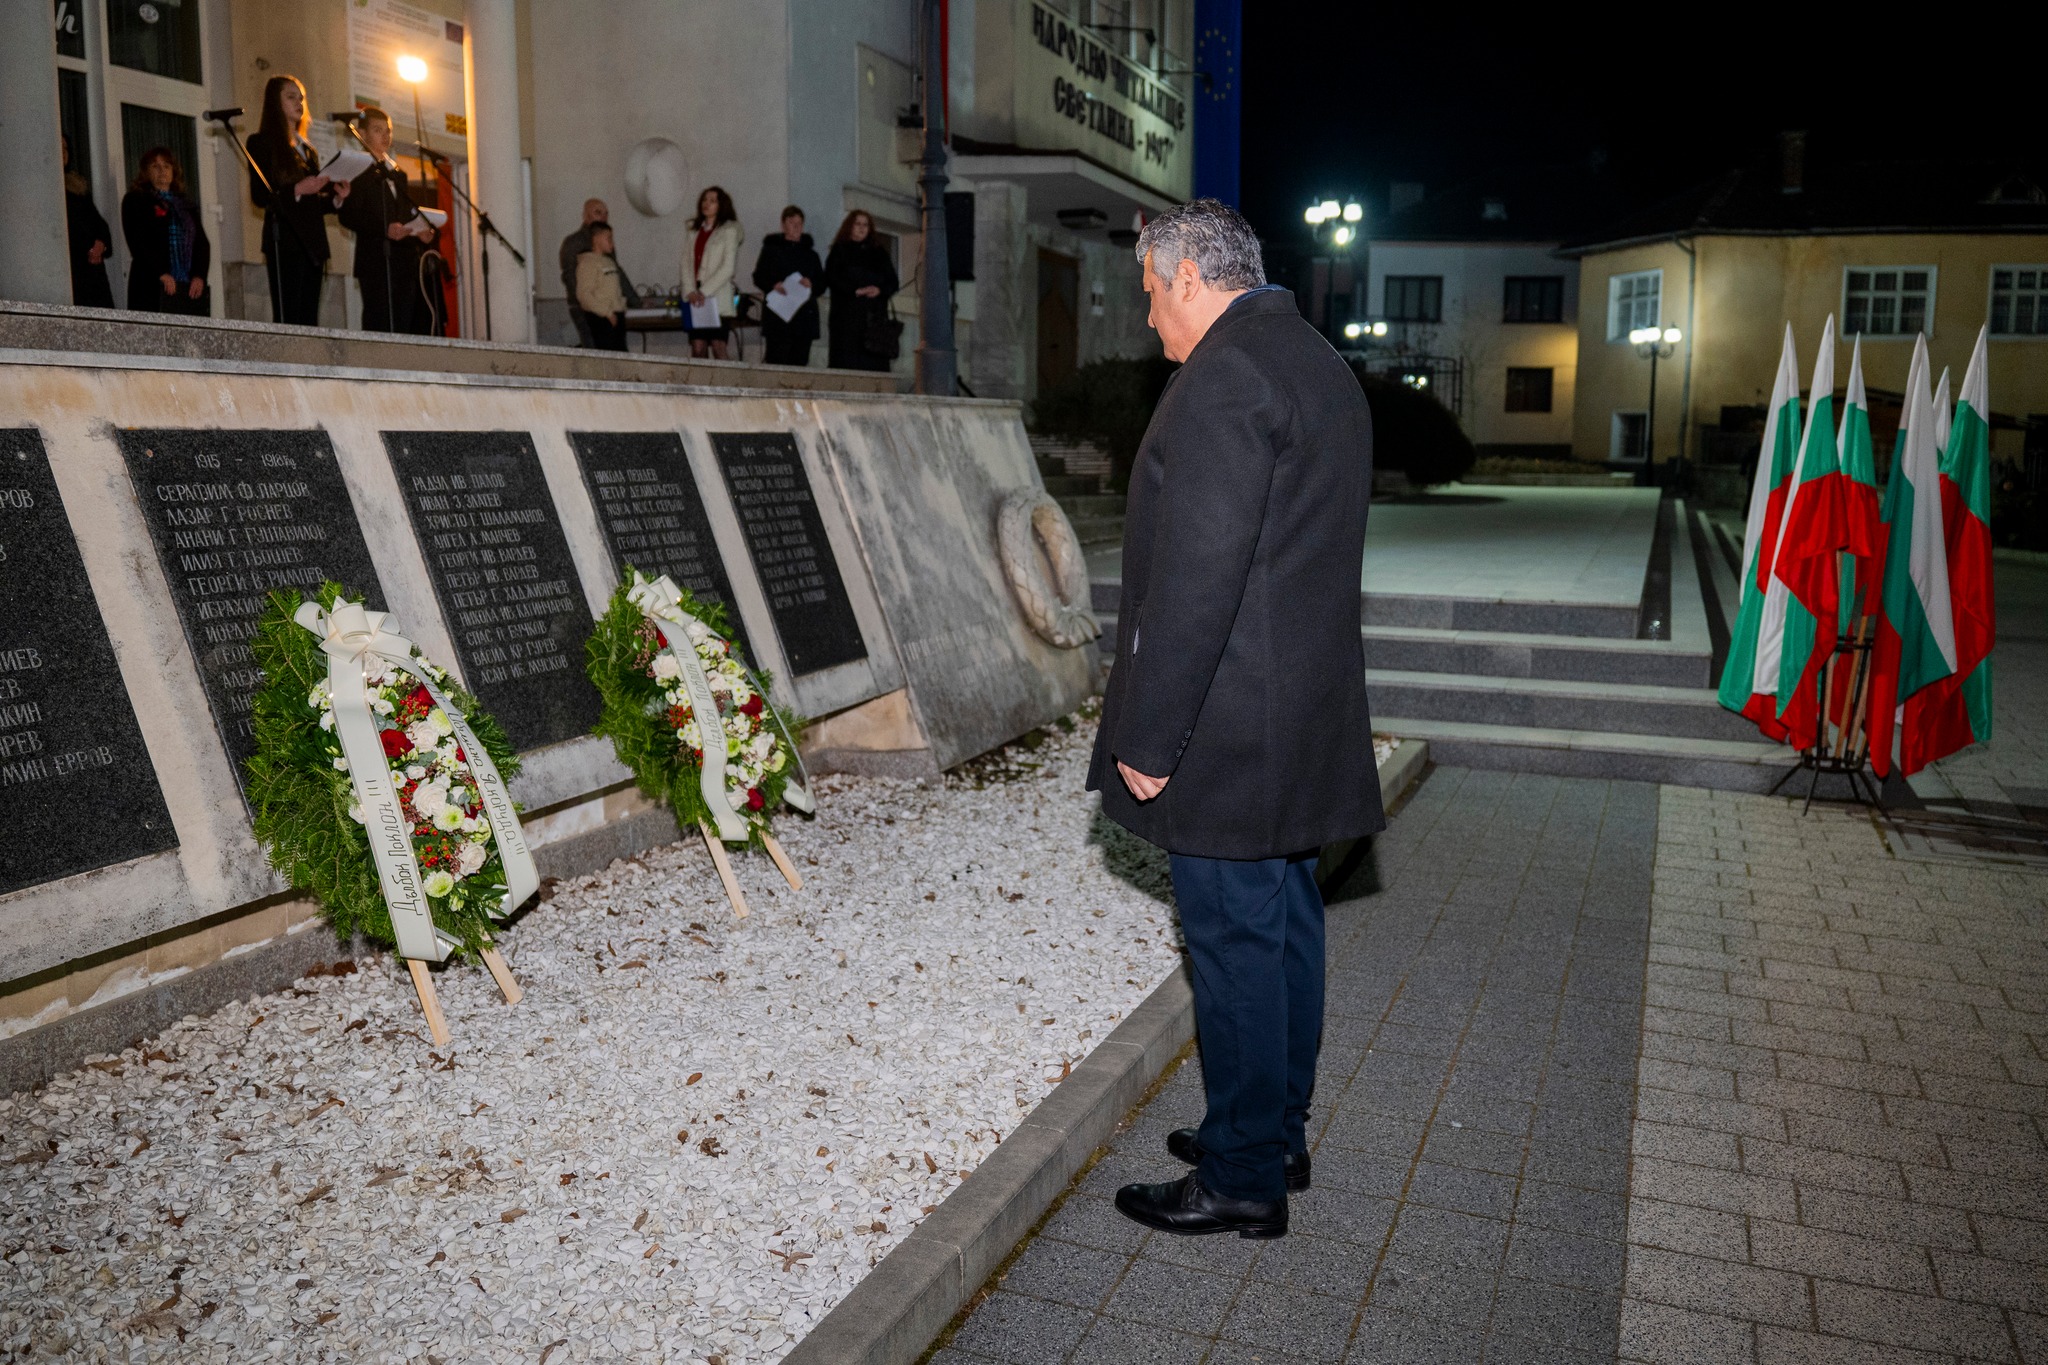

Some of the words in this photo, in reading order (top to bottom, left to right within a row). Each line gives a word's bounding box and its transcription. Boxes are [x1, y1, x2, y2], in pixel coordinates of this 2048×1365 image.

[194, 453, 220, 468] 1915
[412, 474, 448, 492] РАДУЛ
[593, 470, 626, 484] НИКОЛА
[156, 483, 234, 502] СЕРАФИМ
[419, 495, 450, 511] ИВАН
[166, 507, 213, 526] ЛАЗАР
[425, 513, 467, 530] ХРИСТО
[479, 509, 545, 526] ШАЛАМАНОВ
[175, 530, 225, 549] АНАНИ
[433, 532, 466, 549] АНГЕЛ
[480, 528, 521, 545] МАНЧЕВ
[180, 553, 223, 572] ИЛИЯ
[439, 550, 480, 569] ГЕОРГИ
[187, 574, 248, 596] ГЕОРГИ
[446, 571, 481, 589] ПЕТЪР
[453, 590, 488, 608] ПЕТЪР
[458, 608, 499, 627] НИКОЛА
[465, 629, 493, 646] СПАС
[0, 648, 42, 671] ИЕВ
[473, 648, 508, 667] ВАСИЛ
[480, 667, 508, 686] АСАН
[380, 800, 411, 859] Поклон
[391, 862, 424, 916] Дълбок
